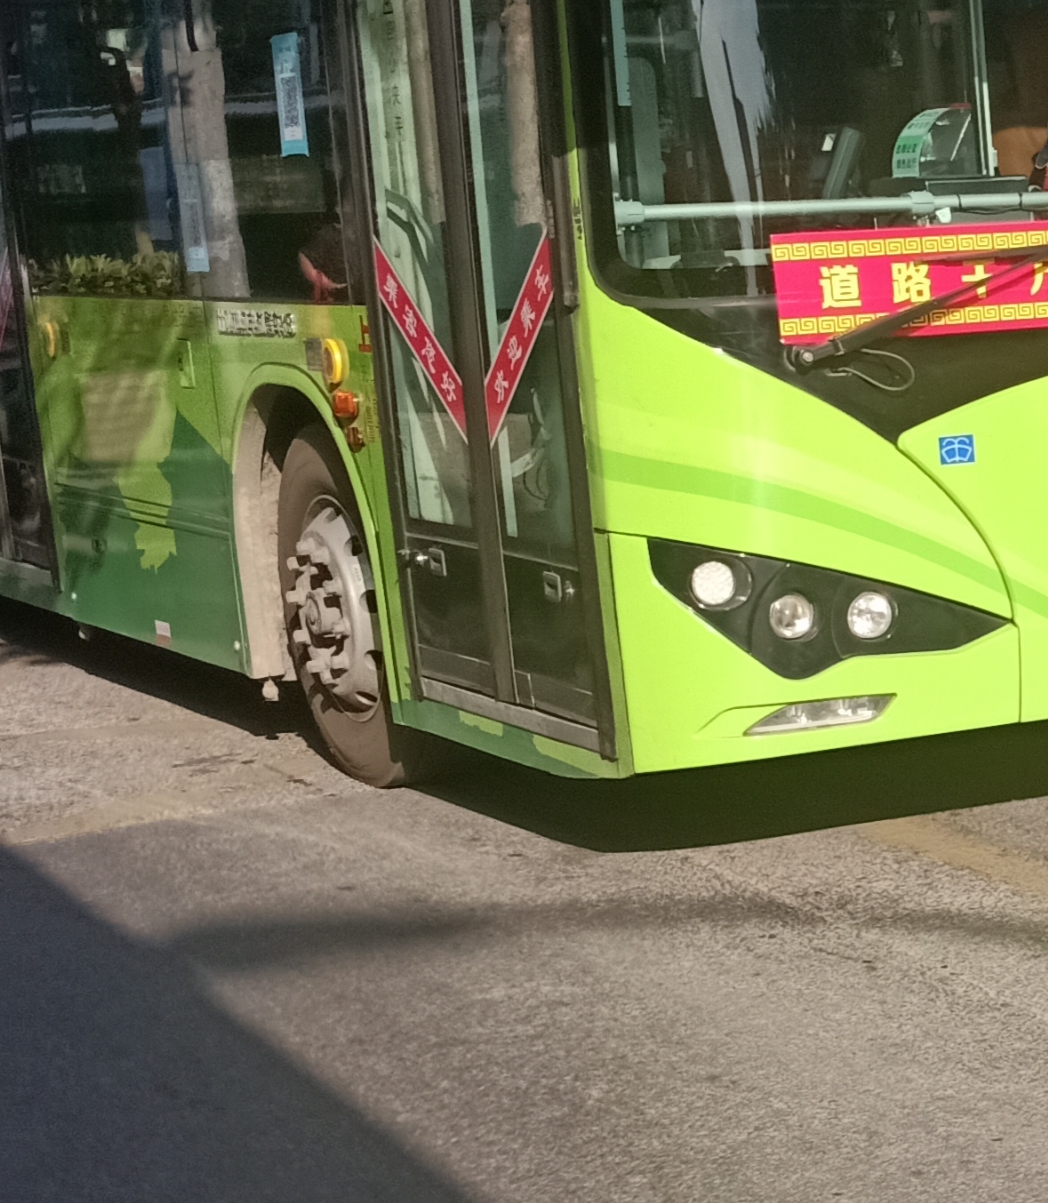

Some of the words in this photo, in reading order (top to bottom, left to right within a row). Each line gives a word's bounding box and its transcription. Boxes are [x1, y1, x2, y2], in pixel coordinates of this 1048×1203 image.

[383, 272, 457, 403] 乘客您好
[494, 264, 549, 404] 欢迎乘车
